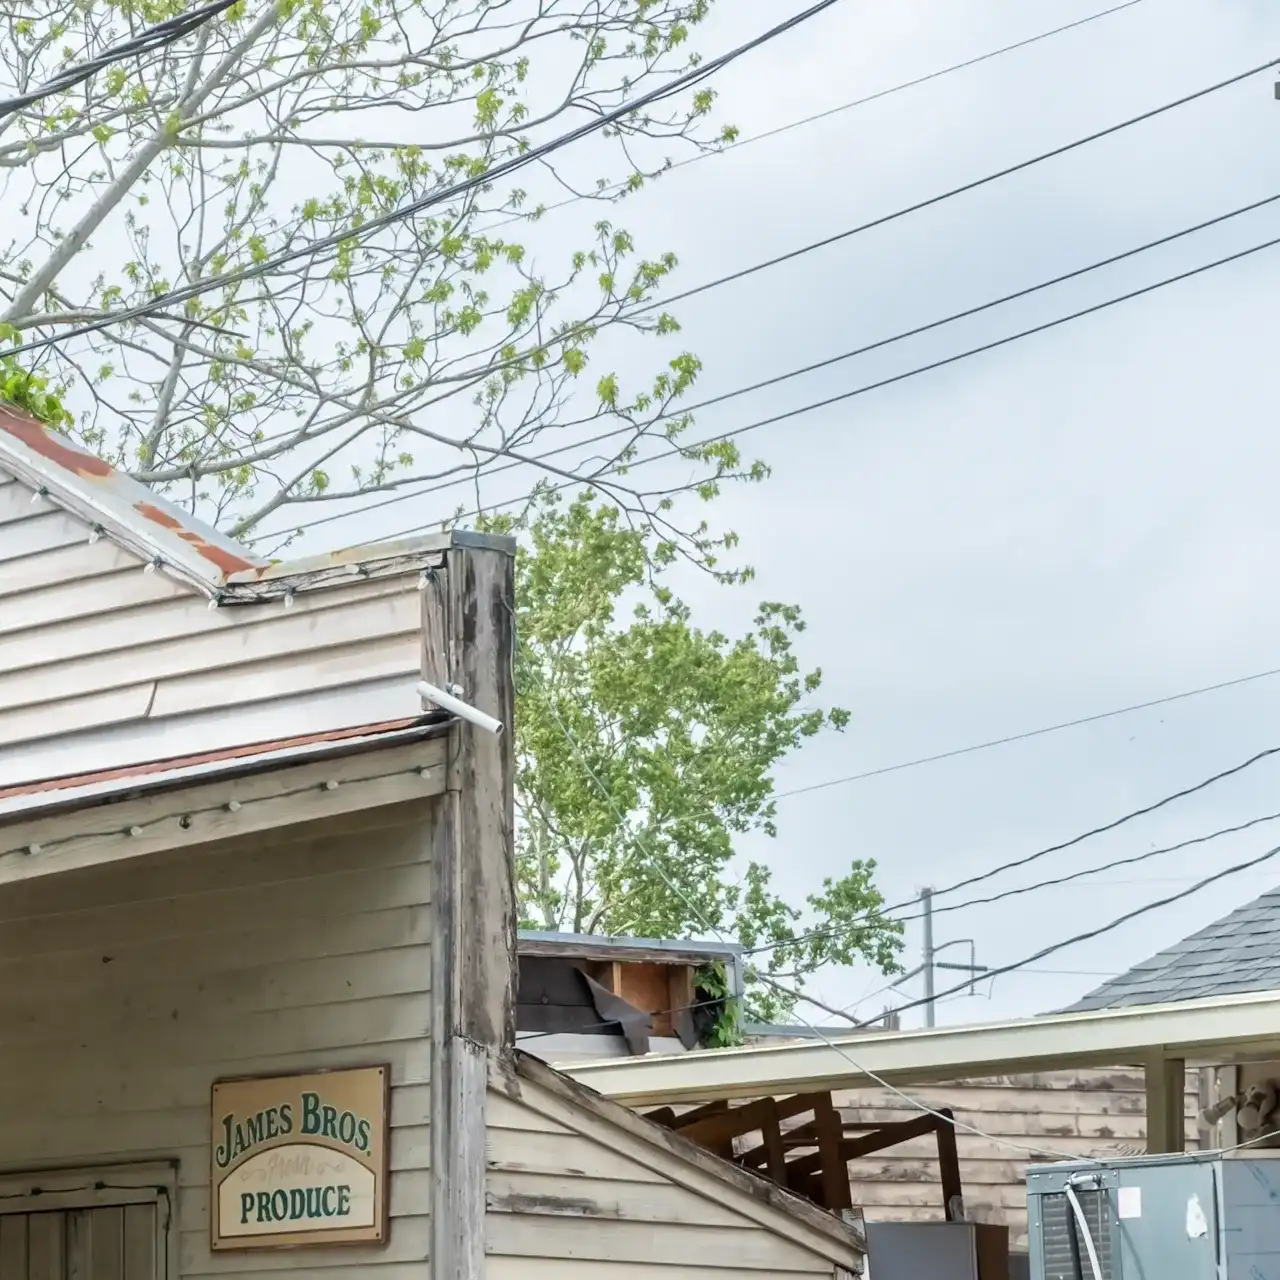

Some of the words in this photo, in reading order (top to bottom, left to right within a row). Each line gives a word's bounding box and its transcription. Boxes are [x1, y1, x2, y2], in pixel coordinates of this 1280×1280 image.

[216, 1103, 292, 1168] JAMES
[300, 1092, 372, 1157] BROS.
[240, 1184, 351, 1224] PRODUCE
